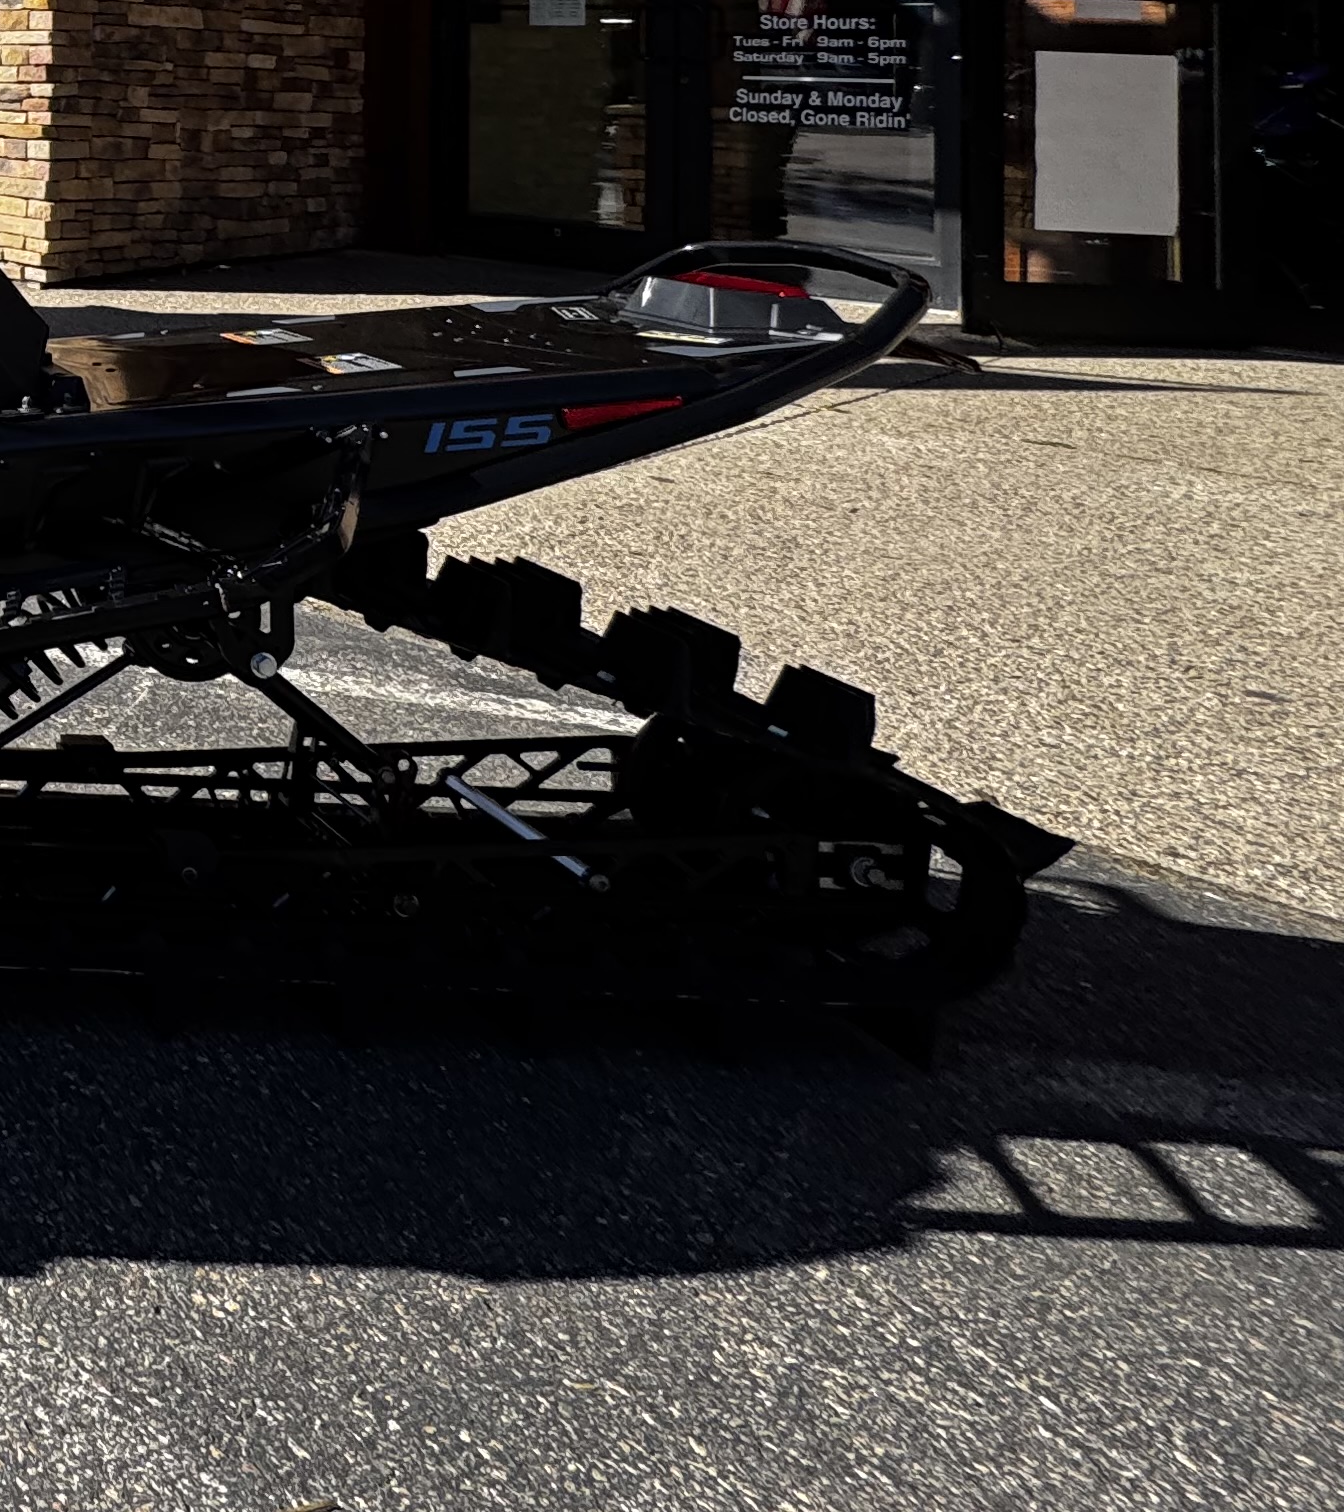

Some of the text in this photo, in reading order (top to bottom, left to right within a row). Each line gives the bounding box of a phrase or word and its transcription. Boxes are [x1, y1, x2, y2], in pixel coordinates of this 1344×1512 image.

[760, 14, 876, 30] Store Hours:
[733, 36, 770, 47] Tues
[782, 36, 804, 47] Fri
[817, 36, 854, 48] 9am
[867, 36, 907, 50] 6pm
[733, 51, 804, 65] Saturday
[817, 52, 854, 63] 9am
[867, 52, 907, 66] 5pm
[736, 88, 903, 112] Sunday & Monday
[729, 107, 911, 129] Closed, Gone Ridin'
[423, 414, 554, 455] 155
